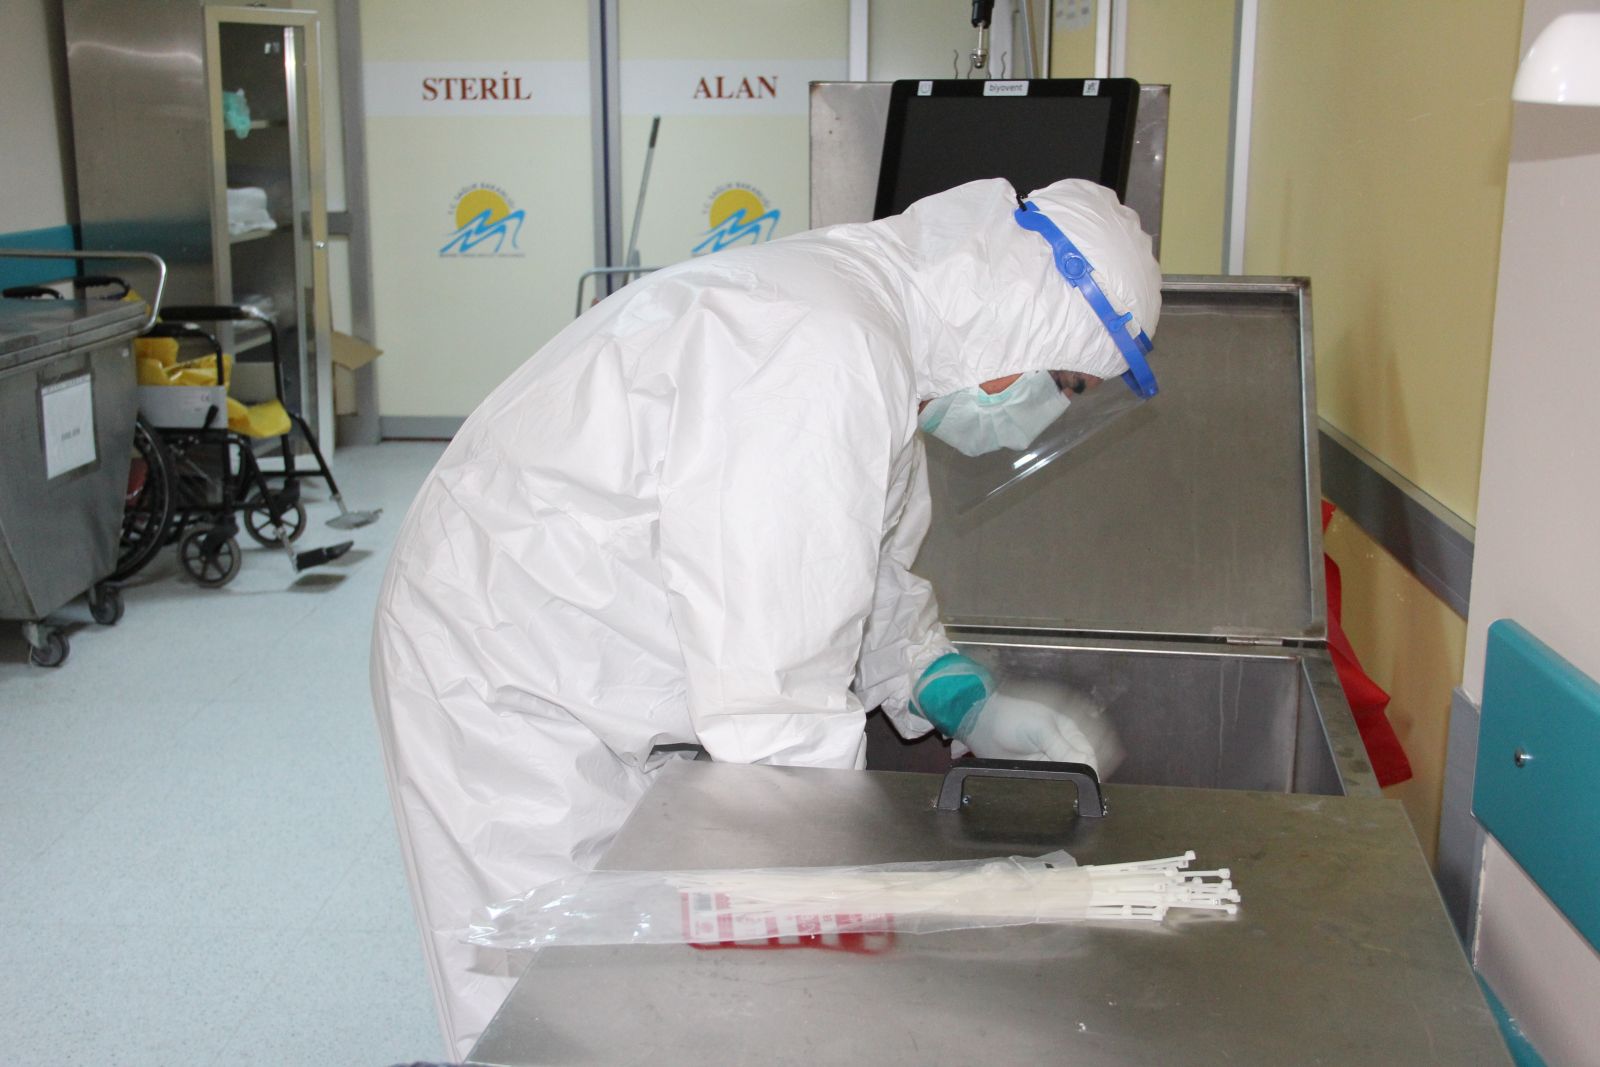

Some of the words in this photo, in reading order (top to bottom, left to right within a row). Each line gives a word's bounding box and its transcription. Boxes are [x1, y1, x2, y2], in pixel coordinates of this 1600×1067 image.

[422, 72, 532, 101] STERİL
[693, 75, 778, 100] ALAN
[989, 83, 1022, 92] biyovent
